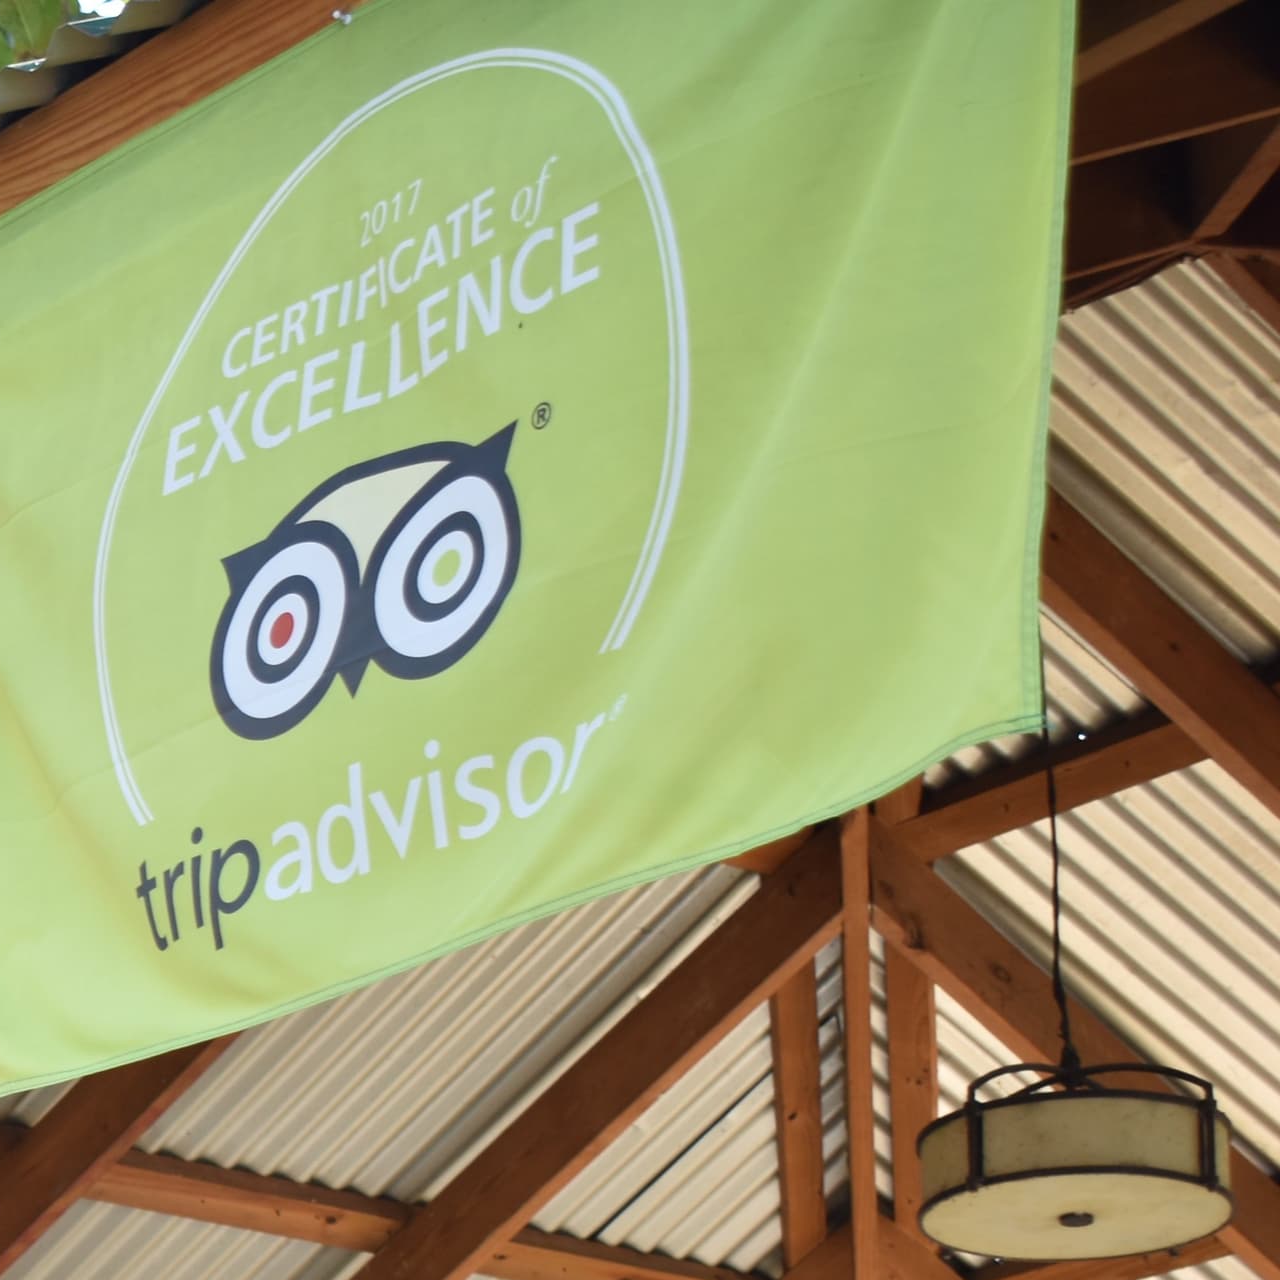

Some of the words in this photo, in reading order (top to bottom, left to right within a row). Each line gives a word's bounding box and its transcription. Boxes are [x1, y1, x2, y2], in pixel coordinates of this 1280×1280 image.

[221, 186, 497, 378] CERTIFICATE
[510, 155, 559, 229] of
[360, 178, 422, 247] 2017
[161, 201, 600, 496] EXCELLENCE
[136, 712, 606, 952] tripadvisor
